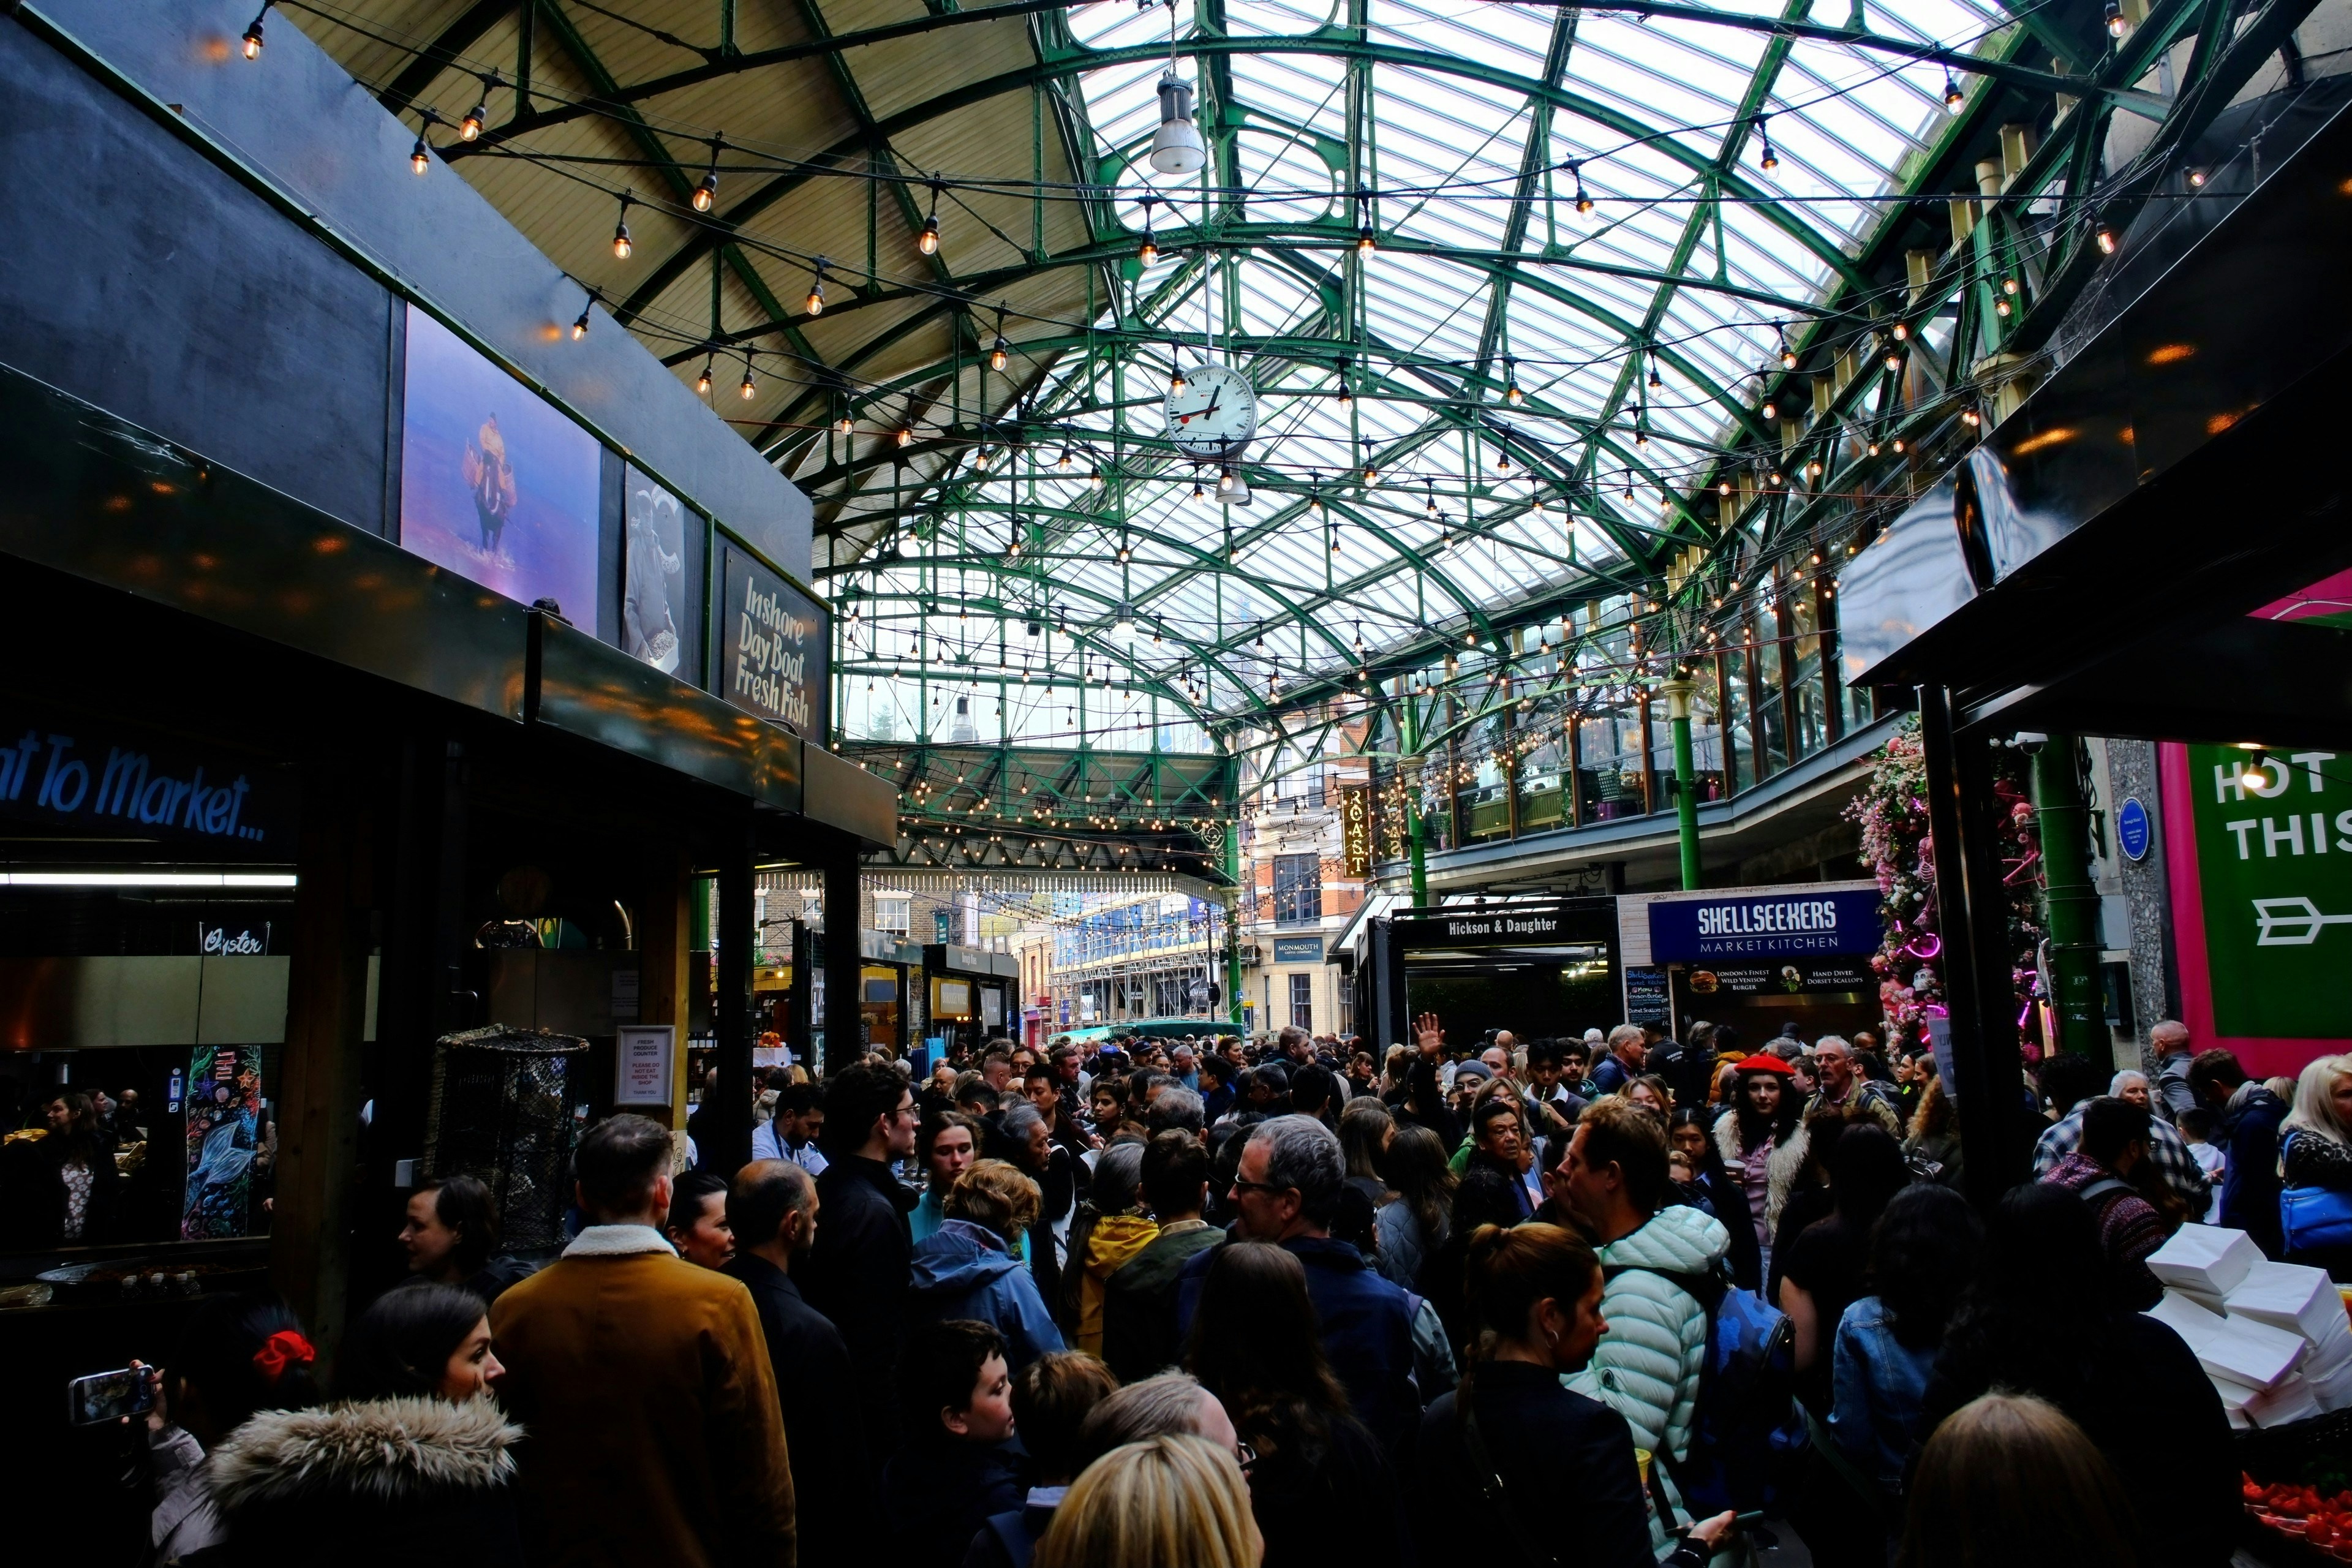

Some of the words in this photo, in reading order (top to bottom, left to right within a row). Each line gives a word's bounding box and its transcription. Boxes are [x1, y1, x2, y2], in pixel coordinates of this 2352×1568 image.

[745, 576, 804, 646] Inshore
[739, 612, 771, 673] Day
[771, 633, 804, 686] Boat
[735, 654, 779, 712] Fresh
[781, 680, 809, 728] Fish
[37, 734, 89, 812] To
[2214, 752, 2336, 804] HOT
[1350, 790, 1365, 872] ROAST
[204, 928, 262, 956] Oyster
[1449, 921, 1490, 935] Hickson
[1494, 919, 1502, 933] &
[1507, 918, 1557, 934] Daughter
[1698, 900, 1836, 935] SHELLSEEKERS
[1700, 940, 1762, 952] MARKET
[1768, 937, 1838, 950] KITCHEN
[1113, 1027, 1132, 1036] MARKET
